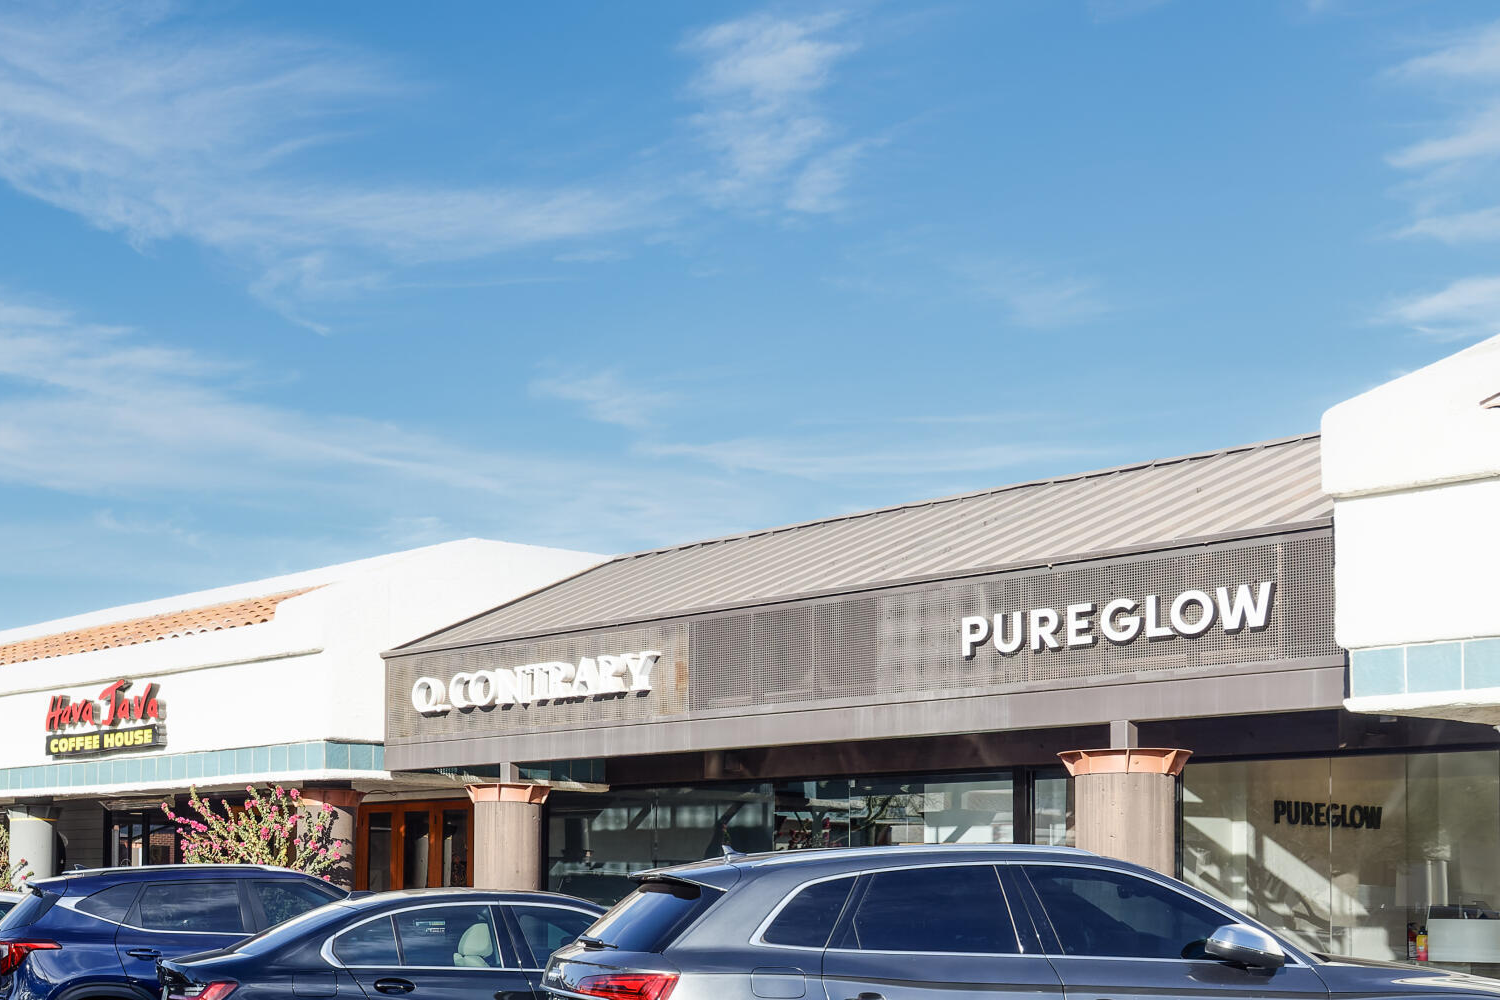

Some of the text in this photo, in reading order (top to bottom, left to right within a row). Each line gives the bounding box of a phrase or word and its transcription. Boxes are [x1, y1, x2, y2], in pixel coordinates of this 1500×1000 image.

[961, 581, 1275, 660] PUREGLOW
[45, 679, 162, 733] Hava Java
[450, 650, 662, 708] CONTRARY
[50, 728, 154, 753] COFFEE HOUSE
[1274, 800, 1383, 830] PUREGLOW
